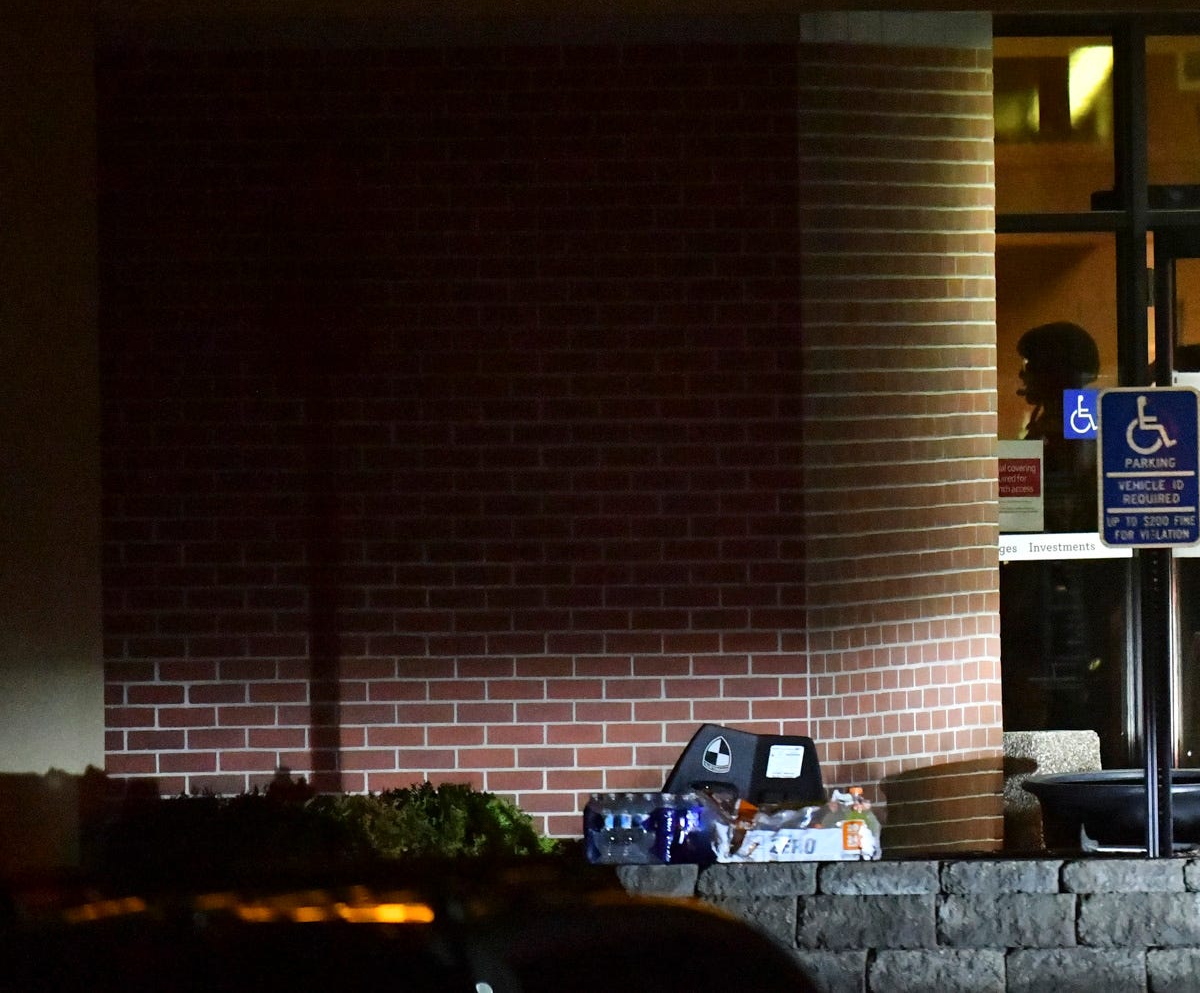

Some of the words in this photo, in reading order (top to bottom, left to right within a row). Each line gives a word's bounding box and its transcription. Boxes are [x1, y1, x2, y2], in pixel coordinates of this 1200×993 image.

[1124, 457, 1176, 469] PARKING
[1007, 465, 1037, 475] covering
[1118, 479, 1166, 491] VEHICLE
[1172, 479, 1185, 490] ID
[1122, 493, 1181, 504] REQUIRED
[1126, 516, 1138, 527] TO
[1143, 515, 1170, 527] $200
[1173, 515, 1196, 526] FINE
[1114, 529, 1135, 540] FOR
[1028, 542, 1096, 553] Investments
